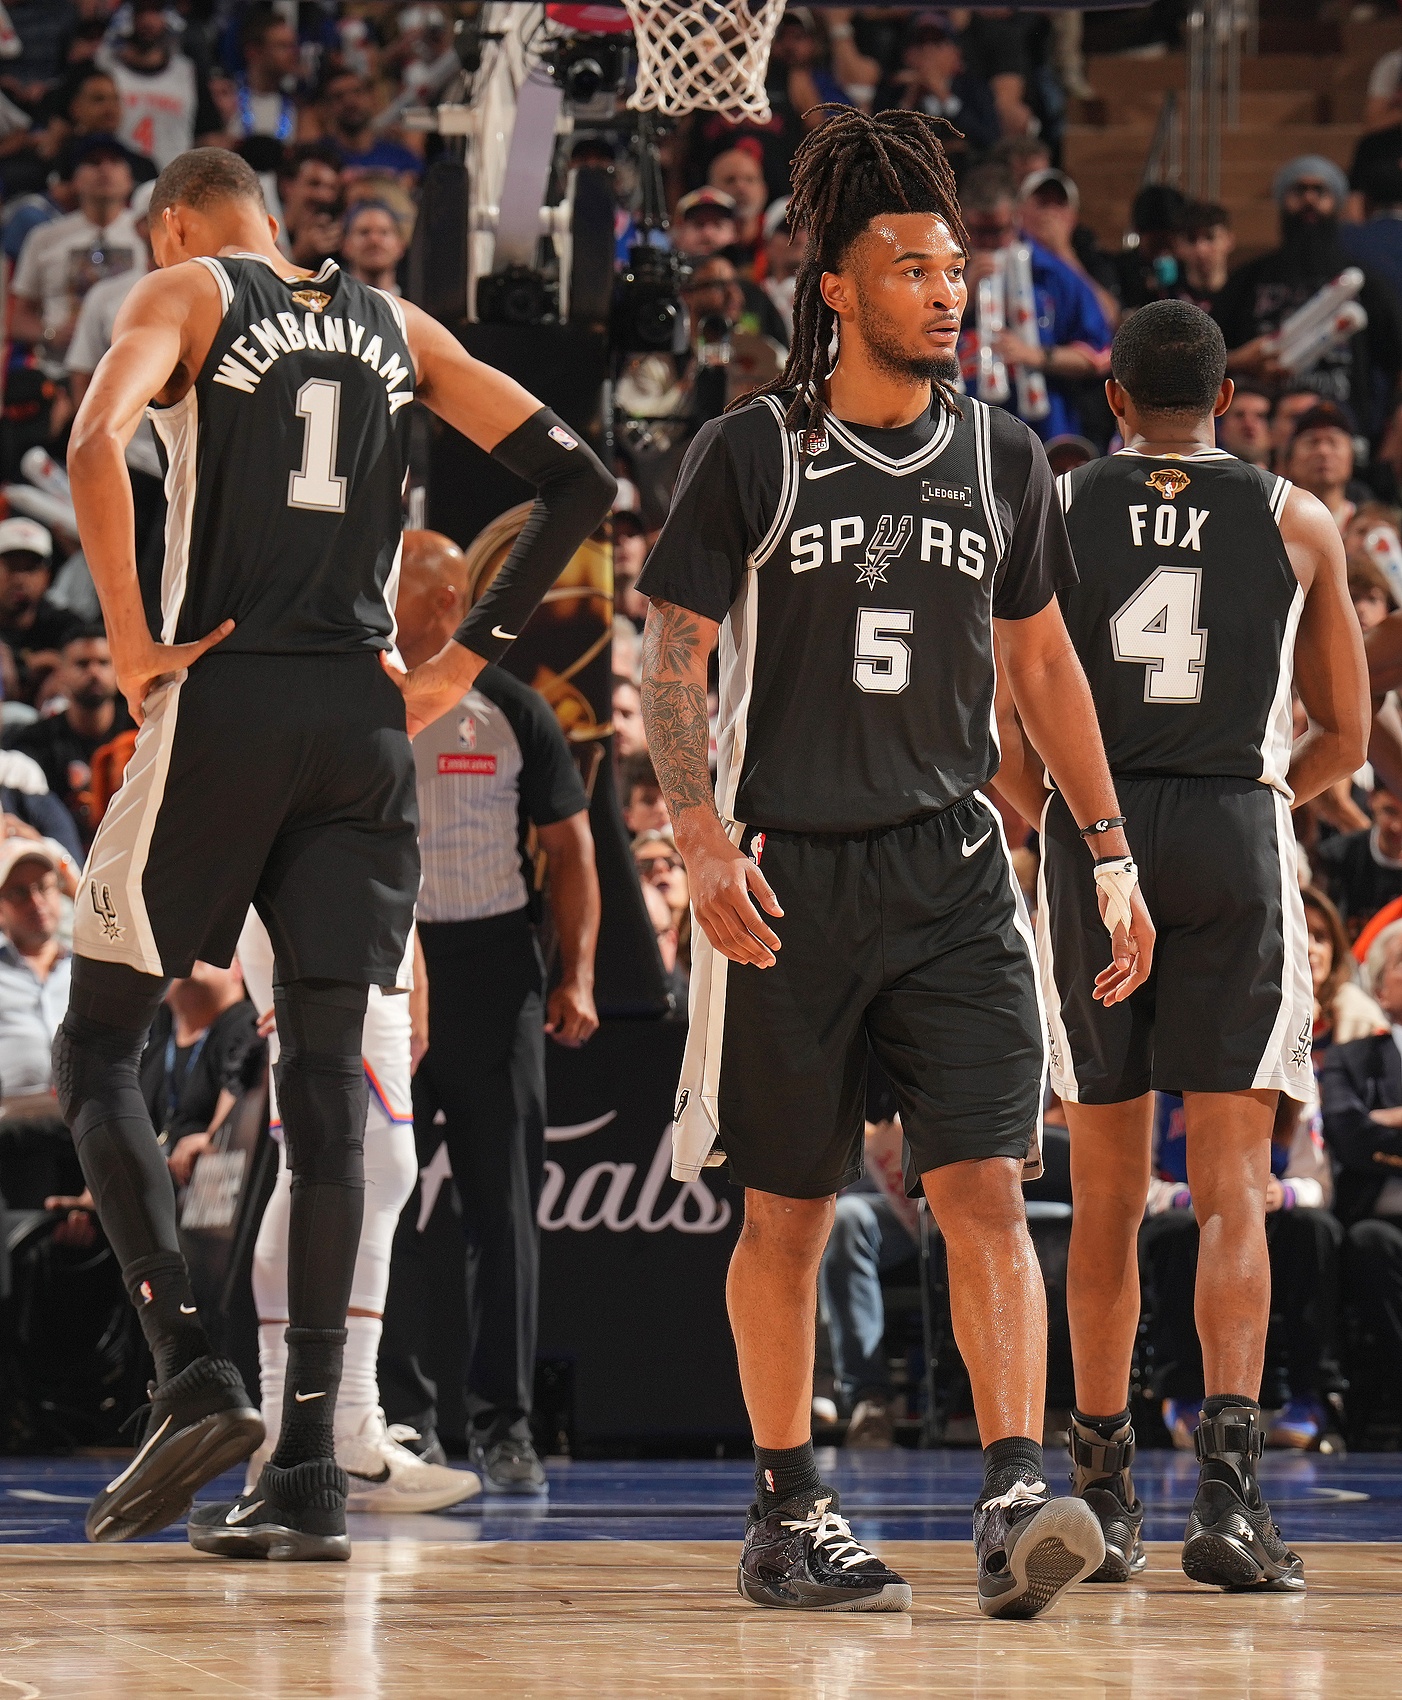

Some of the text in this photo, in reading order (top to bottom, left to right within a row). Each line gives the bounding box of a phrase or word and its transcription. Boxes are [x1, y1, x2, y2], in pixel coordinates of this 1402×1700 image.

[131, 116, 155, 157] 4
[213, 312, 413, 415] WEMBANYAMA
[287, 377, 347, 513] 1
[928, 487, 966, 501] LEDGER
[1128, 504, 1210, 551] FOX
[853, 607, 914, 694] 5
[1109, 565, 1208, 704] 4
